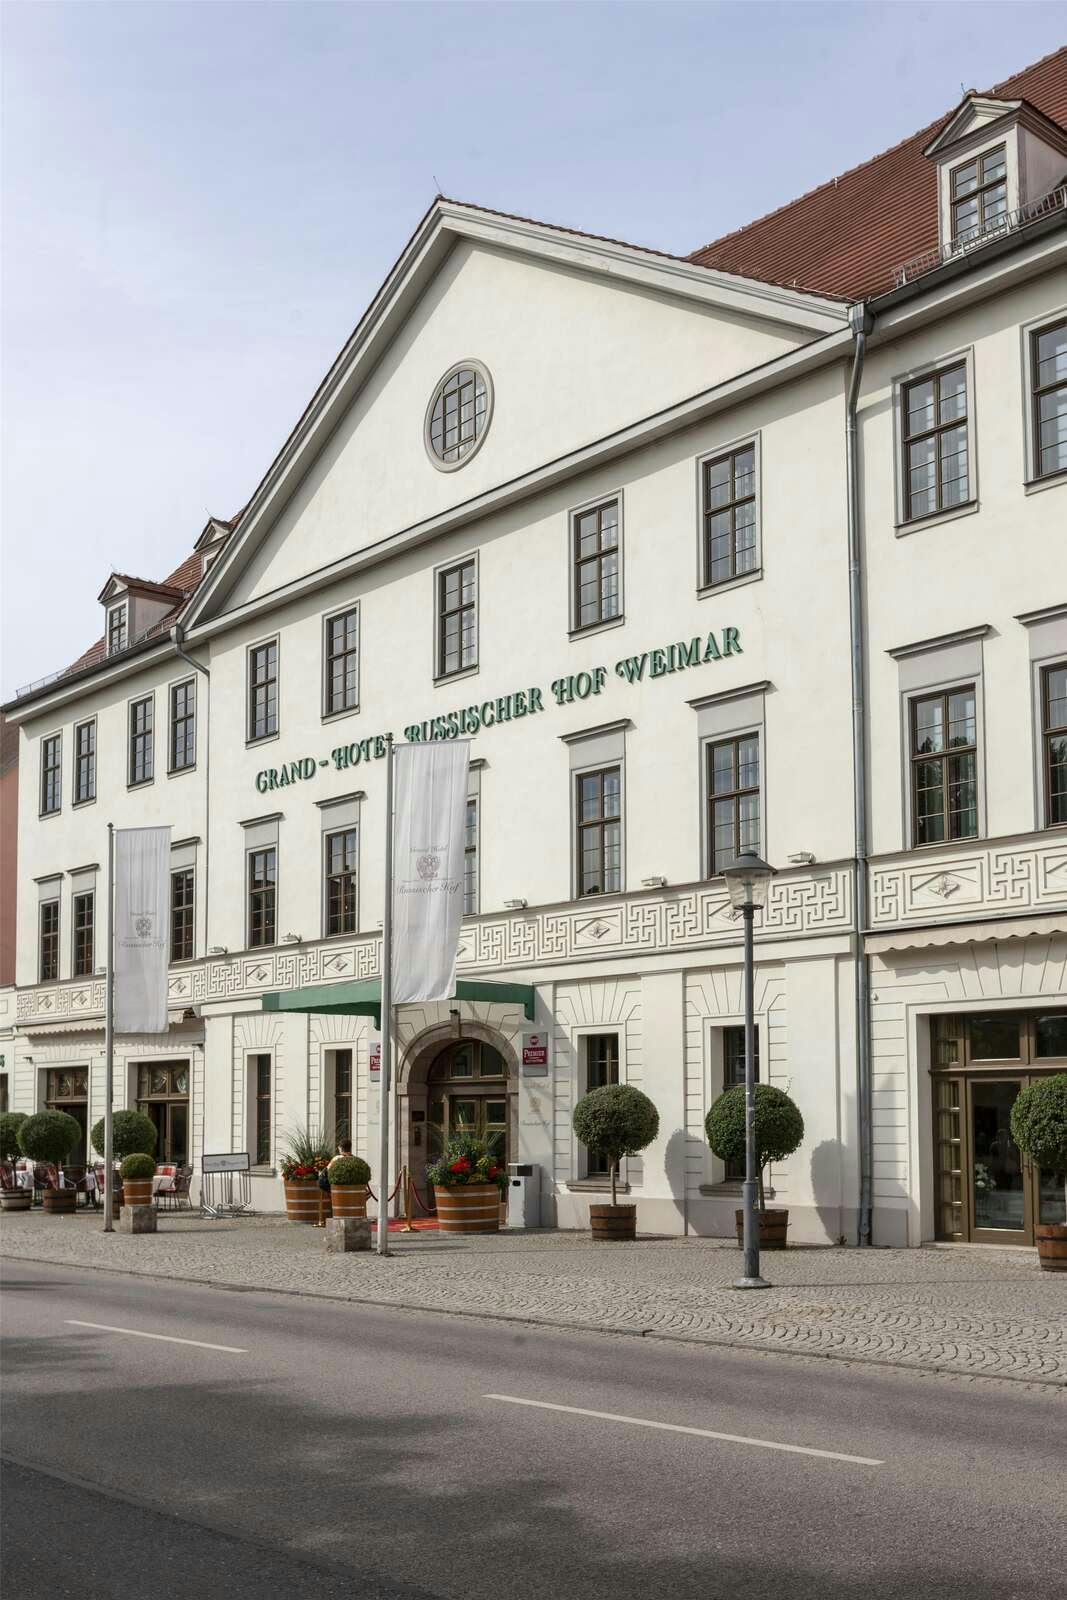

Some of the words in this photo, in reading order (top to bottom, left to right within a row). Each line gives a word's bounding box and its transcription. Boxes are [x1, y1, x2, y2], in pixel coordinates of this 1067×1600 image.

[404, 686, 545, 743] RUSSISCHER
[550, 665, 608, 706] HOF
[615, 626, 744, 685] WEIMAR
